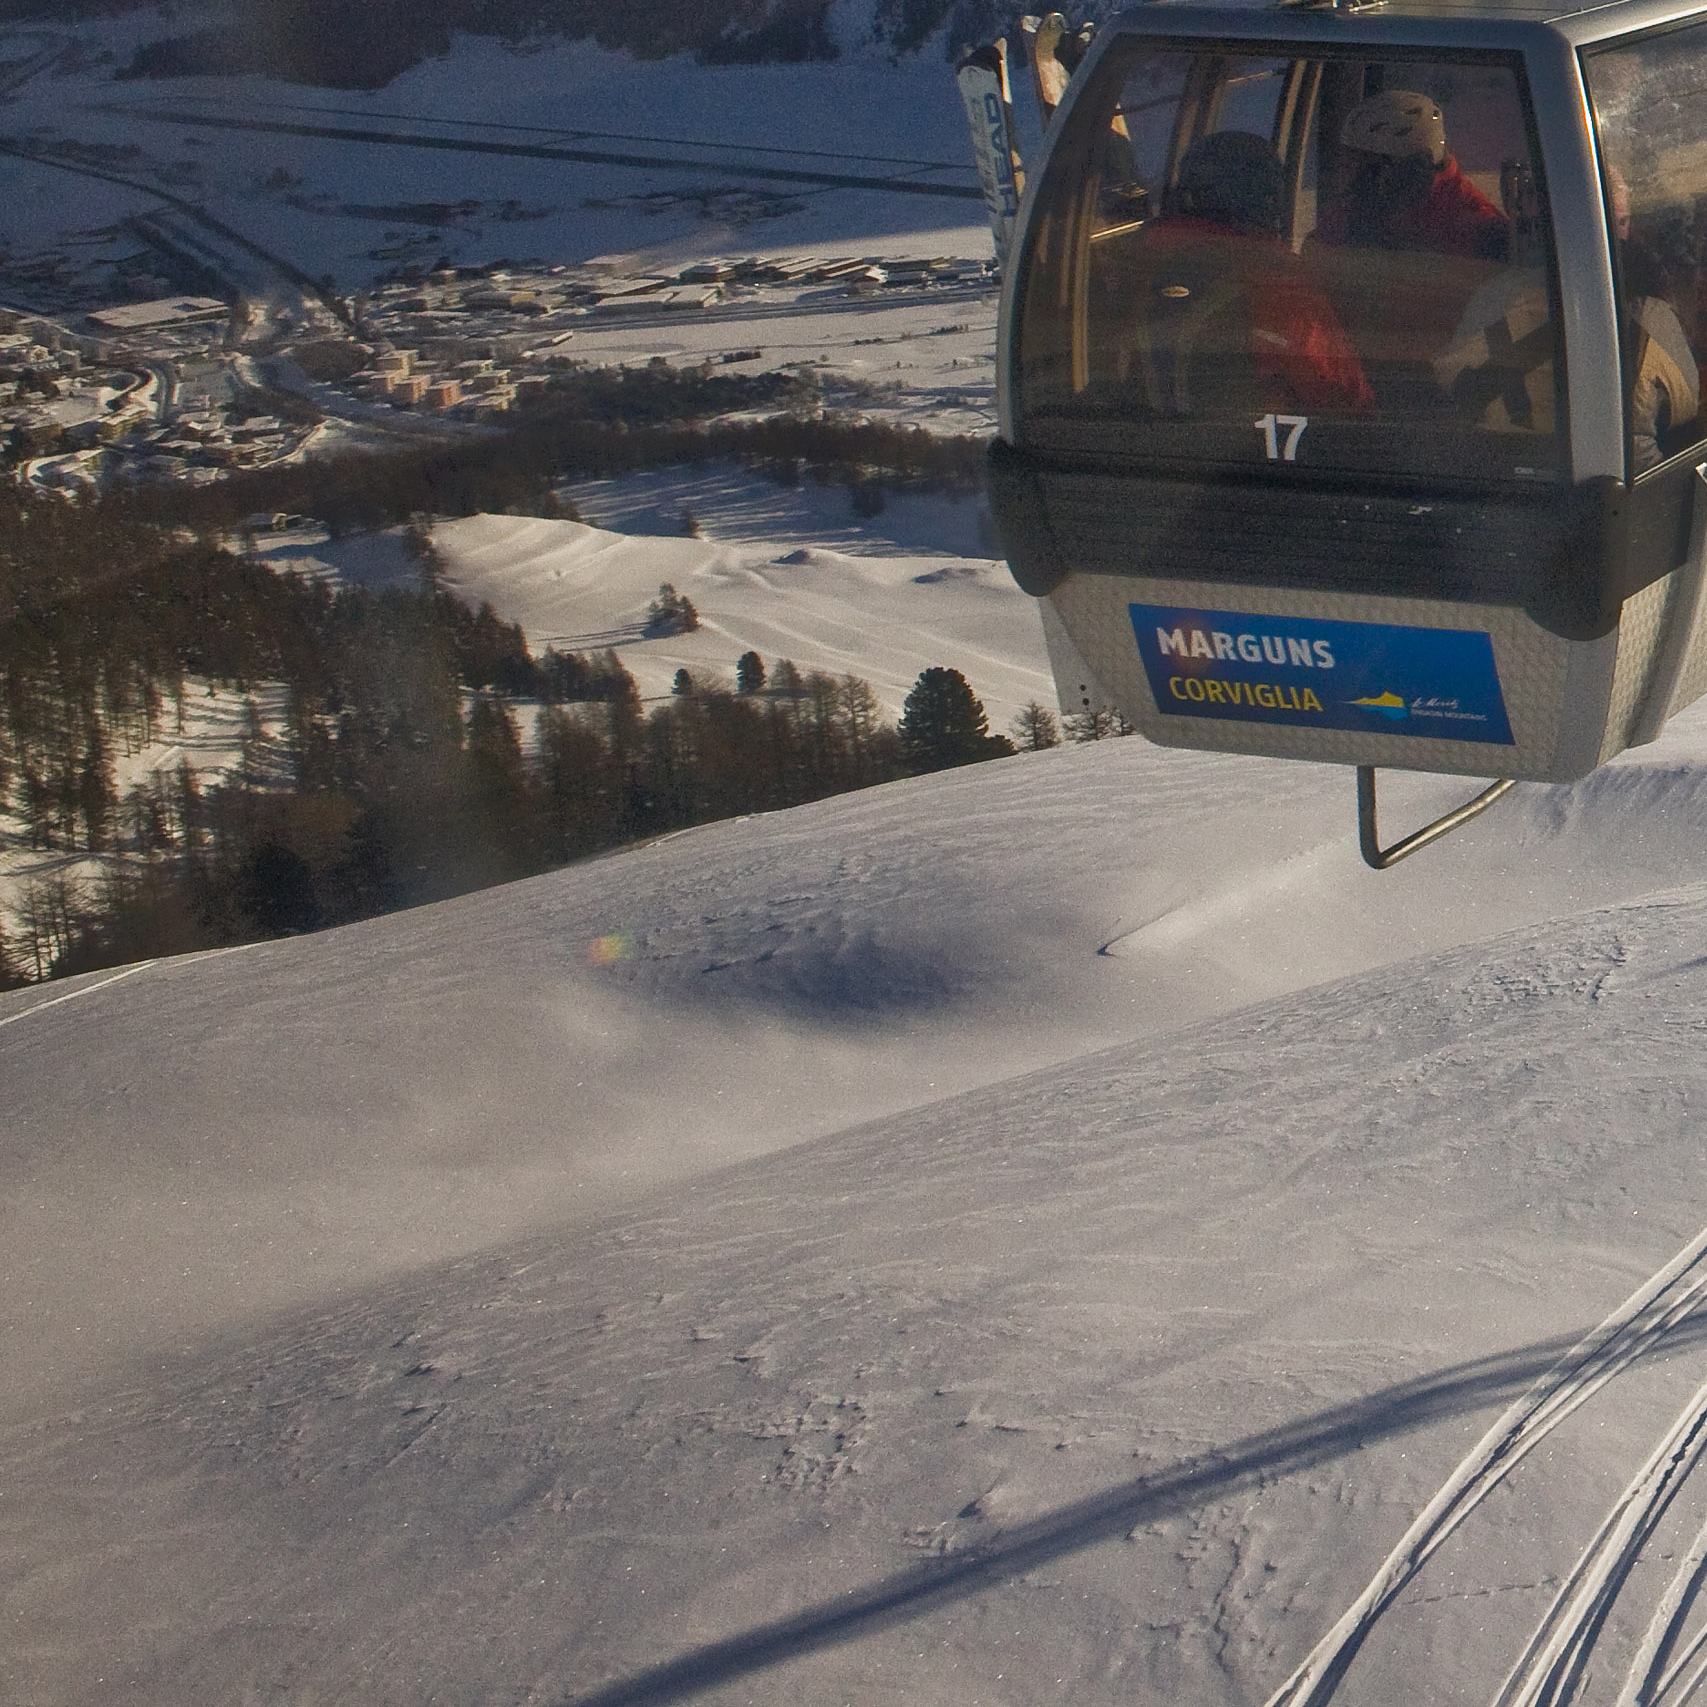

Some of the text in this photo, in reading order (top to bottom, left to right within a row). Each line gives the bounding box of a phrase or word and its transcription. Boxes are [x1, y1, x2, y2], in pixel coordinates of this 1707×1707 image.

[984, 93, 1017, 217] HEAD
[1254, 414, 1308, 461] 17
[1156, 627, 1336, 669] MARGUNS
[1169, 676, 1324, 713] CORVIGLIA
